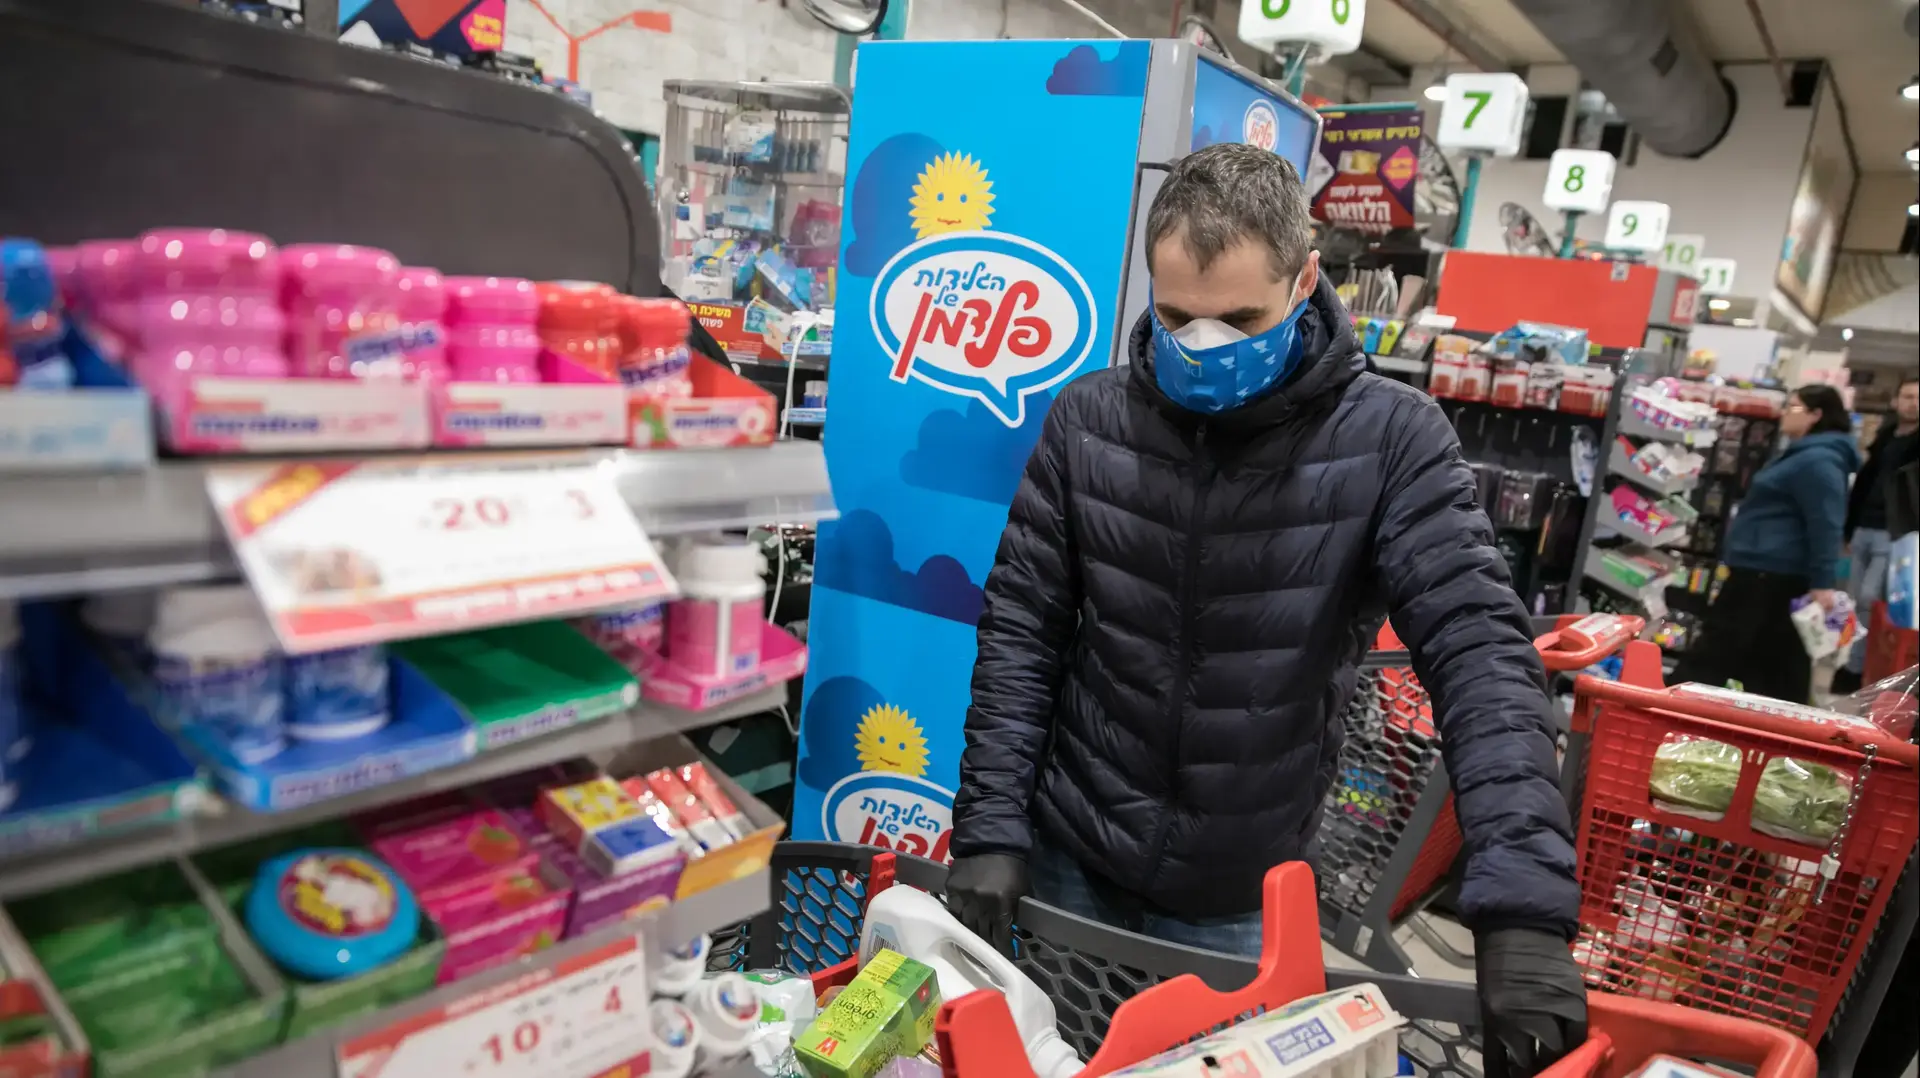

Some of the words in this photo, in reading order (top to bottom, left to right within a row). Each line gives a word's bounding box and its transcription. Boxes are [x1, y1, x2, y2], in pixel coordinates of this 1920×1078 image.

[1463, 91, 1493, 130] 7
[1564, 165, 1585, 192] 8
[1622, 213, 1639, 236] 9
[1664, 242, 1696, 265] 10
[913, 261, 1006, 291] הגלידות
[934, 286, 959, 307] של
[699, 305, 732, 318] משיכת
[893, 280, 1052, 379] פלדמן
[432, 496, 511, 531] 20
[860, 796, 941, 833] הגלידות
[877, 817, 900, 836] של
[838, 998, 878, 1021] green
[482, 1021, 541, 1063] 10
